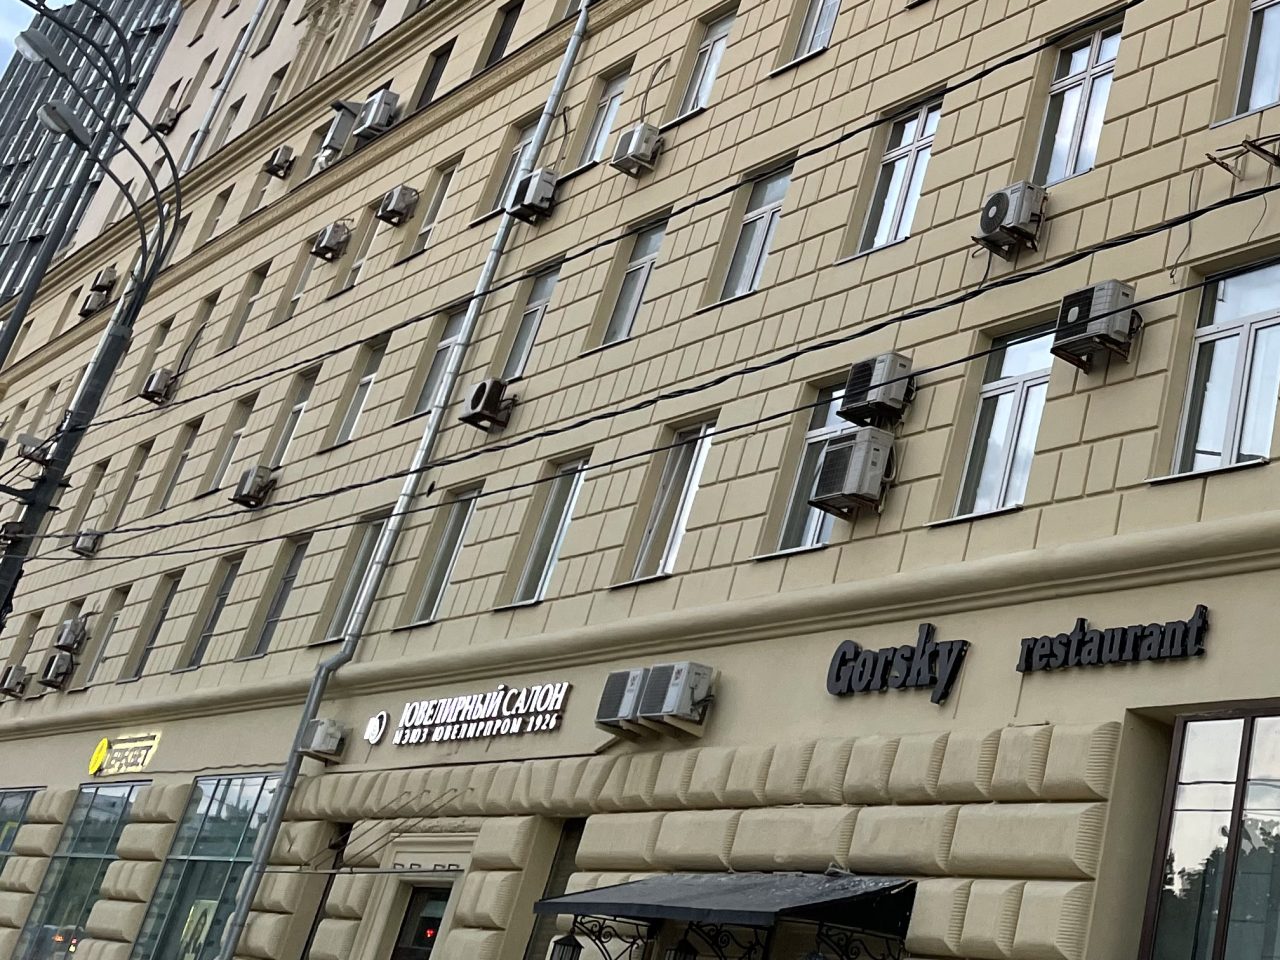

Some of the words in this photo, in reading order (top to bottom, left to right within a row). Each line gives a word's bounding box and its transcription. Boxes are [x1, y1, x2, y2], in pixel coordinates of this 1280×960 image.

[826, 623, 971, 705] Gorsky
[1016, 604, 1209, 673] restaurant
[398, 684, 505, 728] ЮВЕЛИРНЫЙ
[501, 681, 570, 717] САЛОН
[431, 716, 523, 742] ЮВЕЛИРПРОМ
[526, 712, 559, 732] 1926
